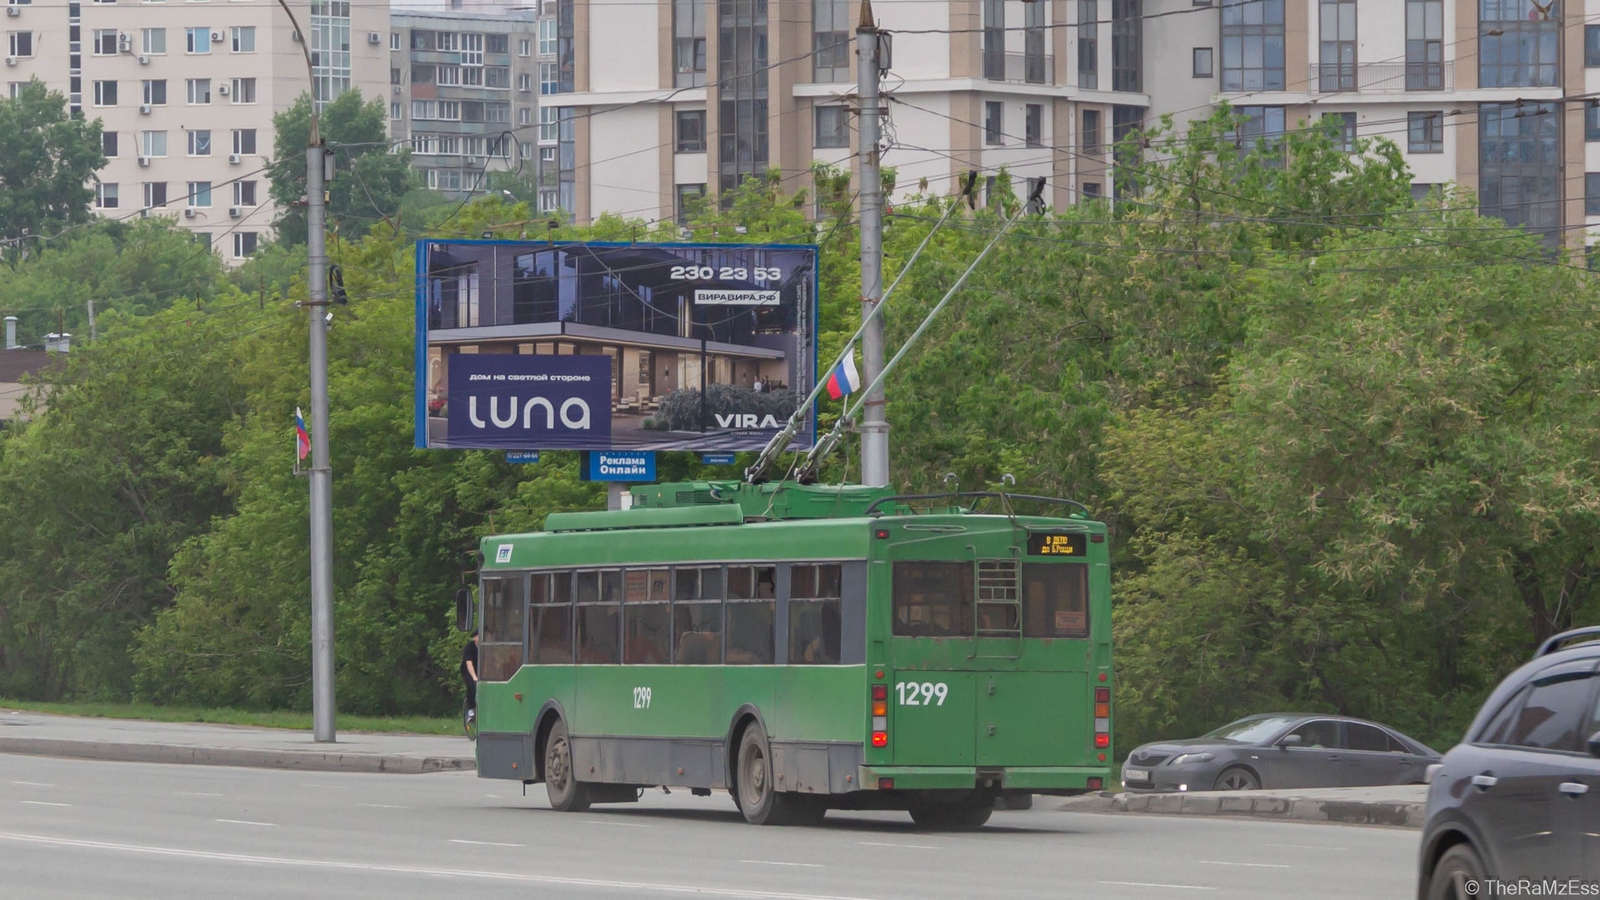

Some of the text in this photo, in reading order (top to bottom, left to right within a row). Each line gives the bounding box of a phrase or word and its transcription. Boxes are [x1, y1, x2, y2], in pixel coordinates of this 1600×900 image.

[670, 265, 782, 280] 230 23 53
[698, 293, 776, 301] ВИРАВИРА.РФ
[714, 413, 780, 428] VIRA
[600, 456, 646, 465] Реклама
[600, 465, 646, 475] Онлайн
[633, 686, 652, 709] 1299
[895, 681, 949, 706] 1299
